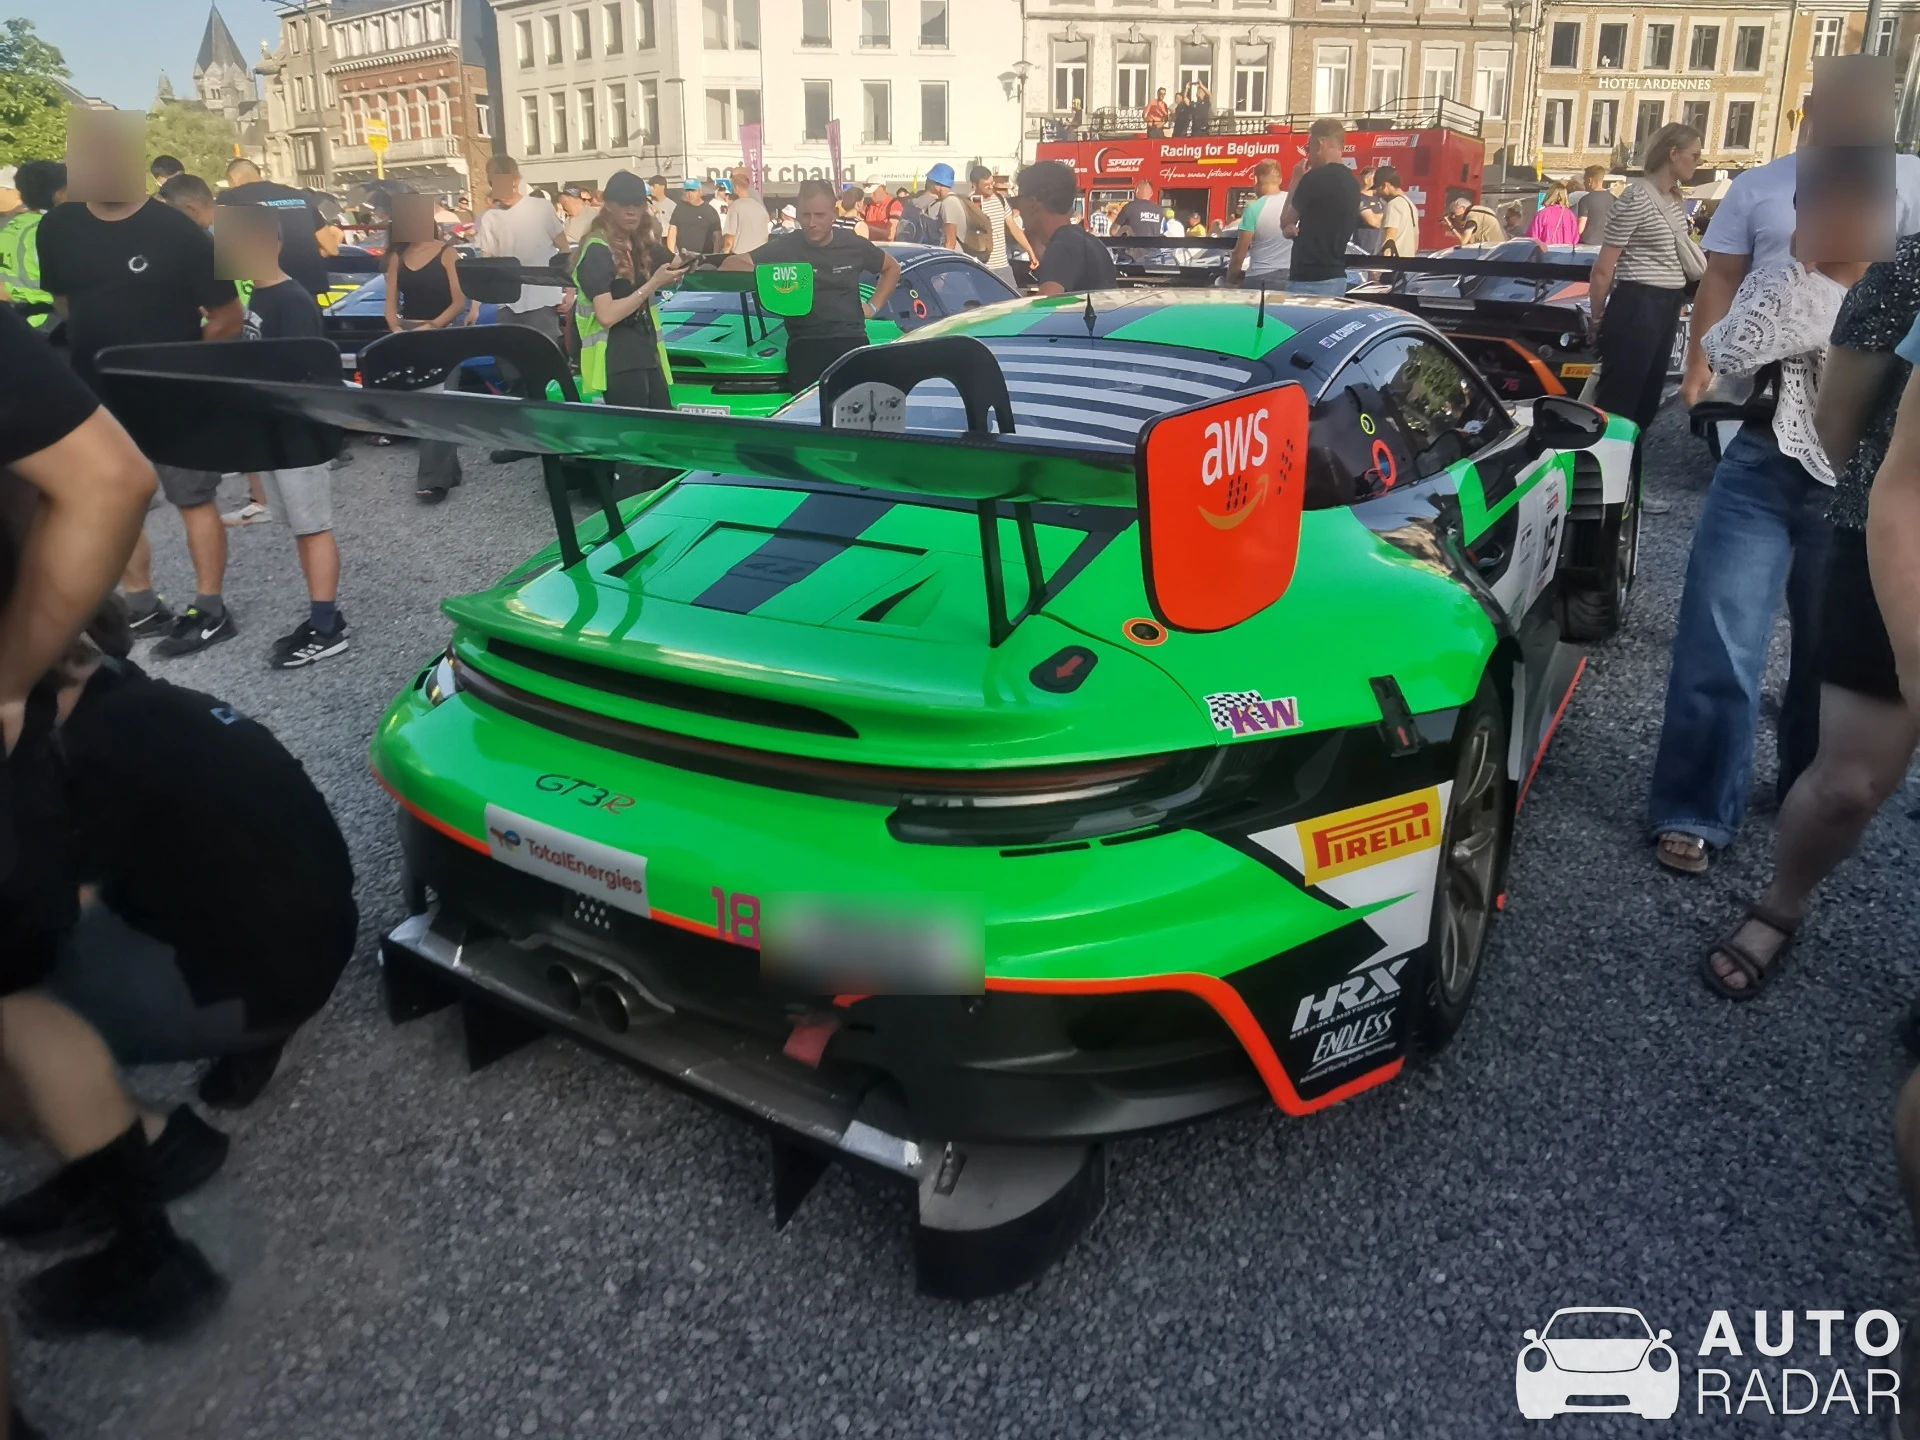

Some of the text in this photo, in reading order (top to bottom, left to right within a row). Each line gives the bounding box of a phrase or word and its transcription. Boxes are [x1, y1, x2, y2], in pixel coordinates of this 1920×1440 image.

[1598, 77, 1711, 90] HOTEL ARDENNES
[1107, 157, 1144, 167] SPORT
[1160, 142, 1279, 159] Racing for Belgium
[772, 265, 797, 281] aws
[1202, 408, 1269, 486] aws
[1228, 698, 1297, 735] KW
[1312, 801, 1431, 869] PIRELLI
[525, 837, 644, 894] TotalEnergies
[711, 885, 760, 950] 18
[1291, 957, 1410, 1033] HRX
[1312, 1006, 1397, 1063] ENDLESS
